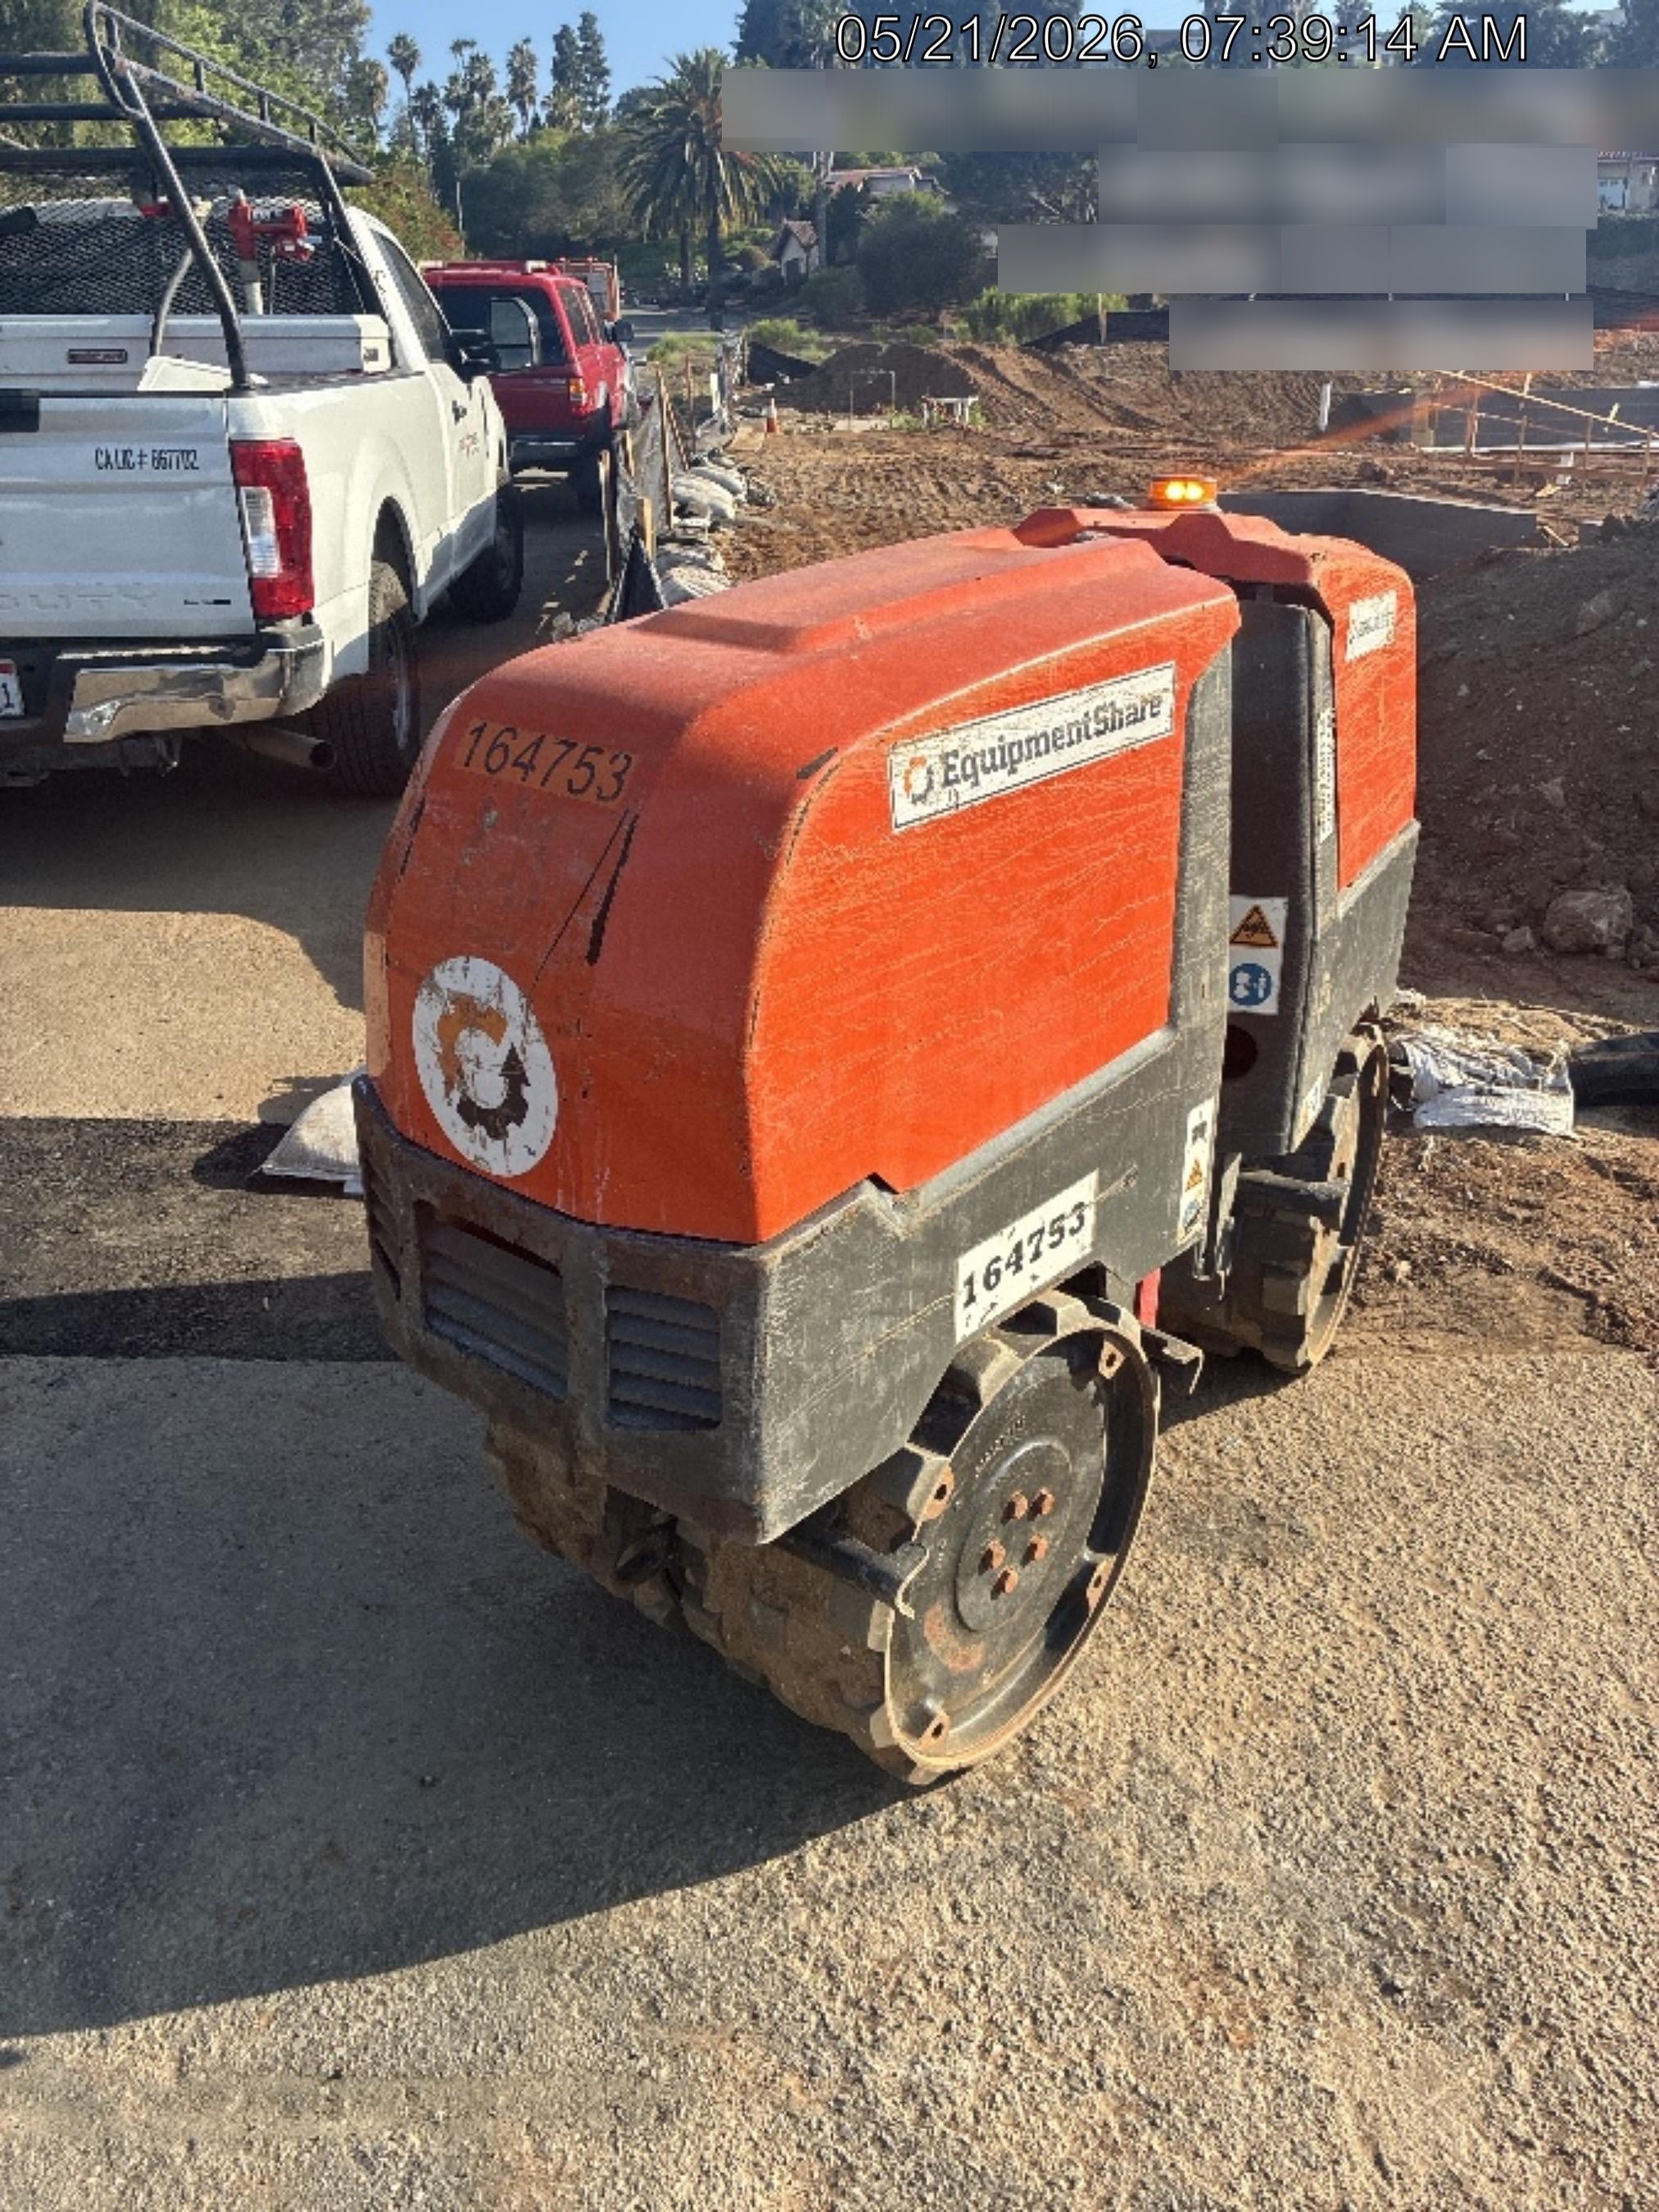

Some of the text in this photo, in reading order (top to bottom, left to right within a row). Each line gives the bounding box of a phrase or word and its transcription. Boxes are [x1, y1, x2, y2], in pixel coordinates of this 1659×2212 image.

[464, 722, 632, 802] 164753
[940, 694, 1164, 789] EquipmentShare
[962, 1201, 1087, 1309] 164753
